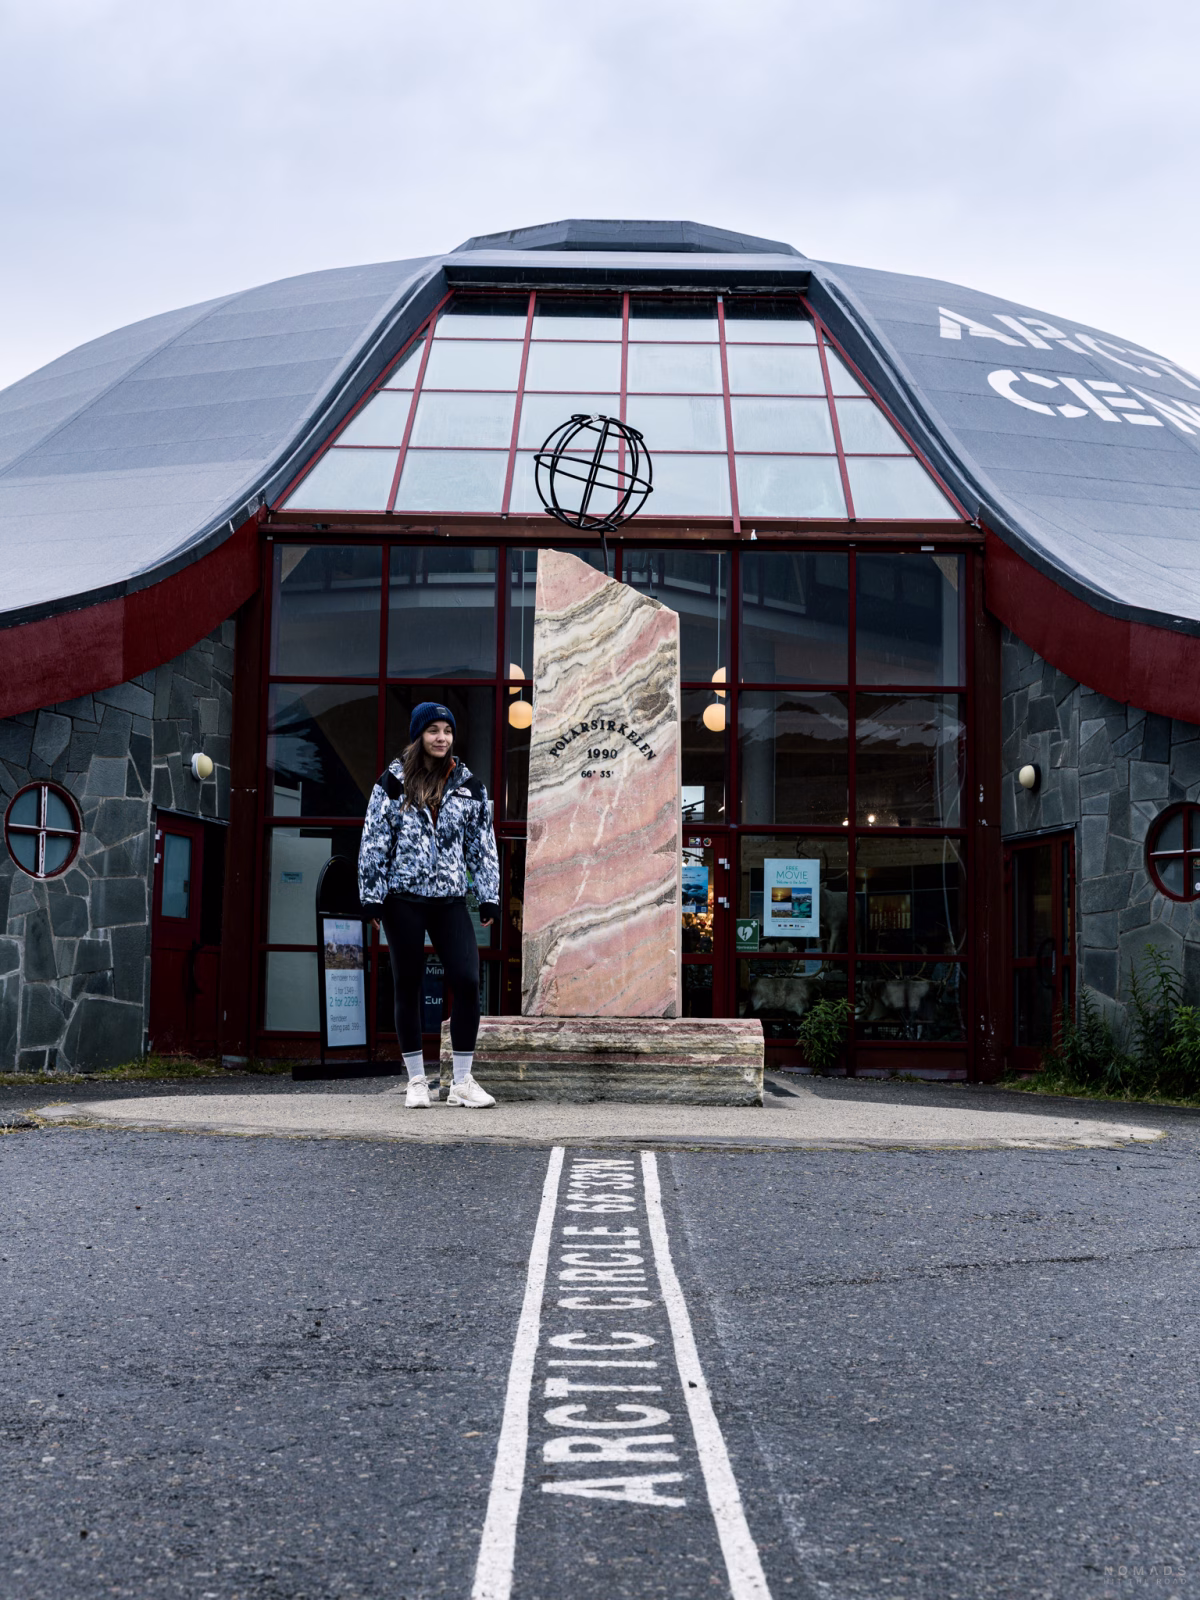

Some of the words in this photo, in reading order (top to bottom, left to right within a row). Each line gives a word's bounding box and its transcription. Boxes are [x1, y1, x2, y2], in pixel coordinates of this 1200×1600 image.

[549, 719, 657, 760] POLARSIRKELEN
[587, 748, 618, 759] 1990
[776, 870, 808, 880] MOVIE
[329, 996, 334, 1007] 2
[557, 1226, 652, 1309] CIRCLE
[541, 1331, 686, 1507] ARCTIC
